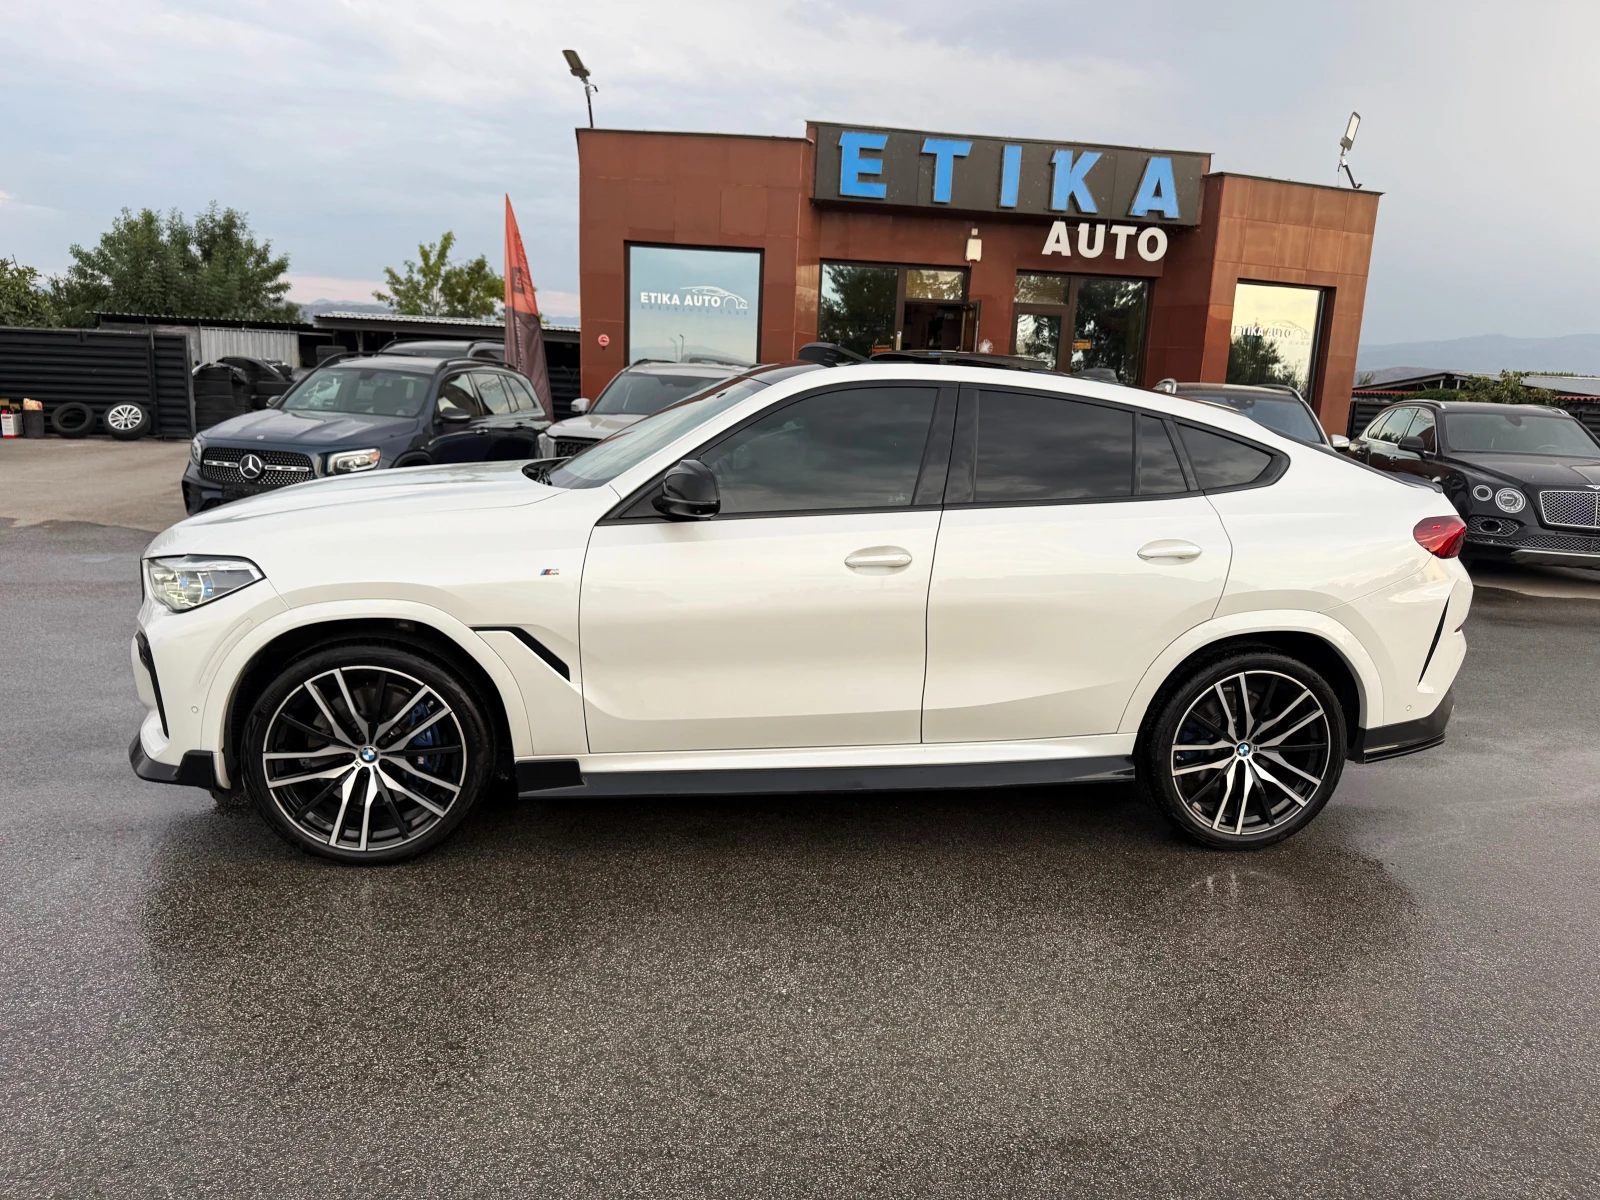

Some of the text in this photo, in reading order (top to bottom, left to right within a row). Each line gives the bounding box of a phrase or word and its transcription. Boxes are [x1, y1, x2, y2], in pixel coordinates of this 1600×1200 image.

[838, 131, 1181, 219] ETIKA
[1042, 221, 1168, 262] AUTO
[640, 292, 721, 308] ETIKA AUTO
